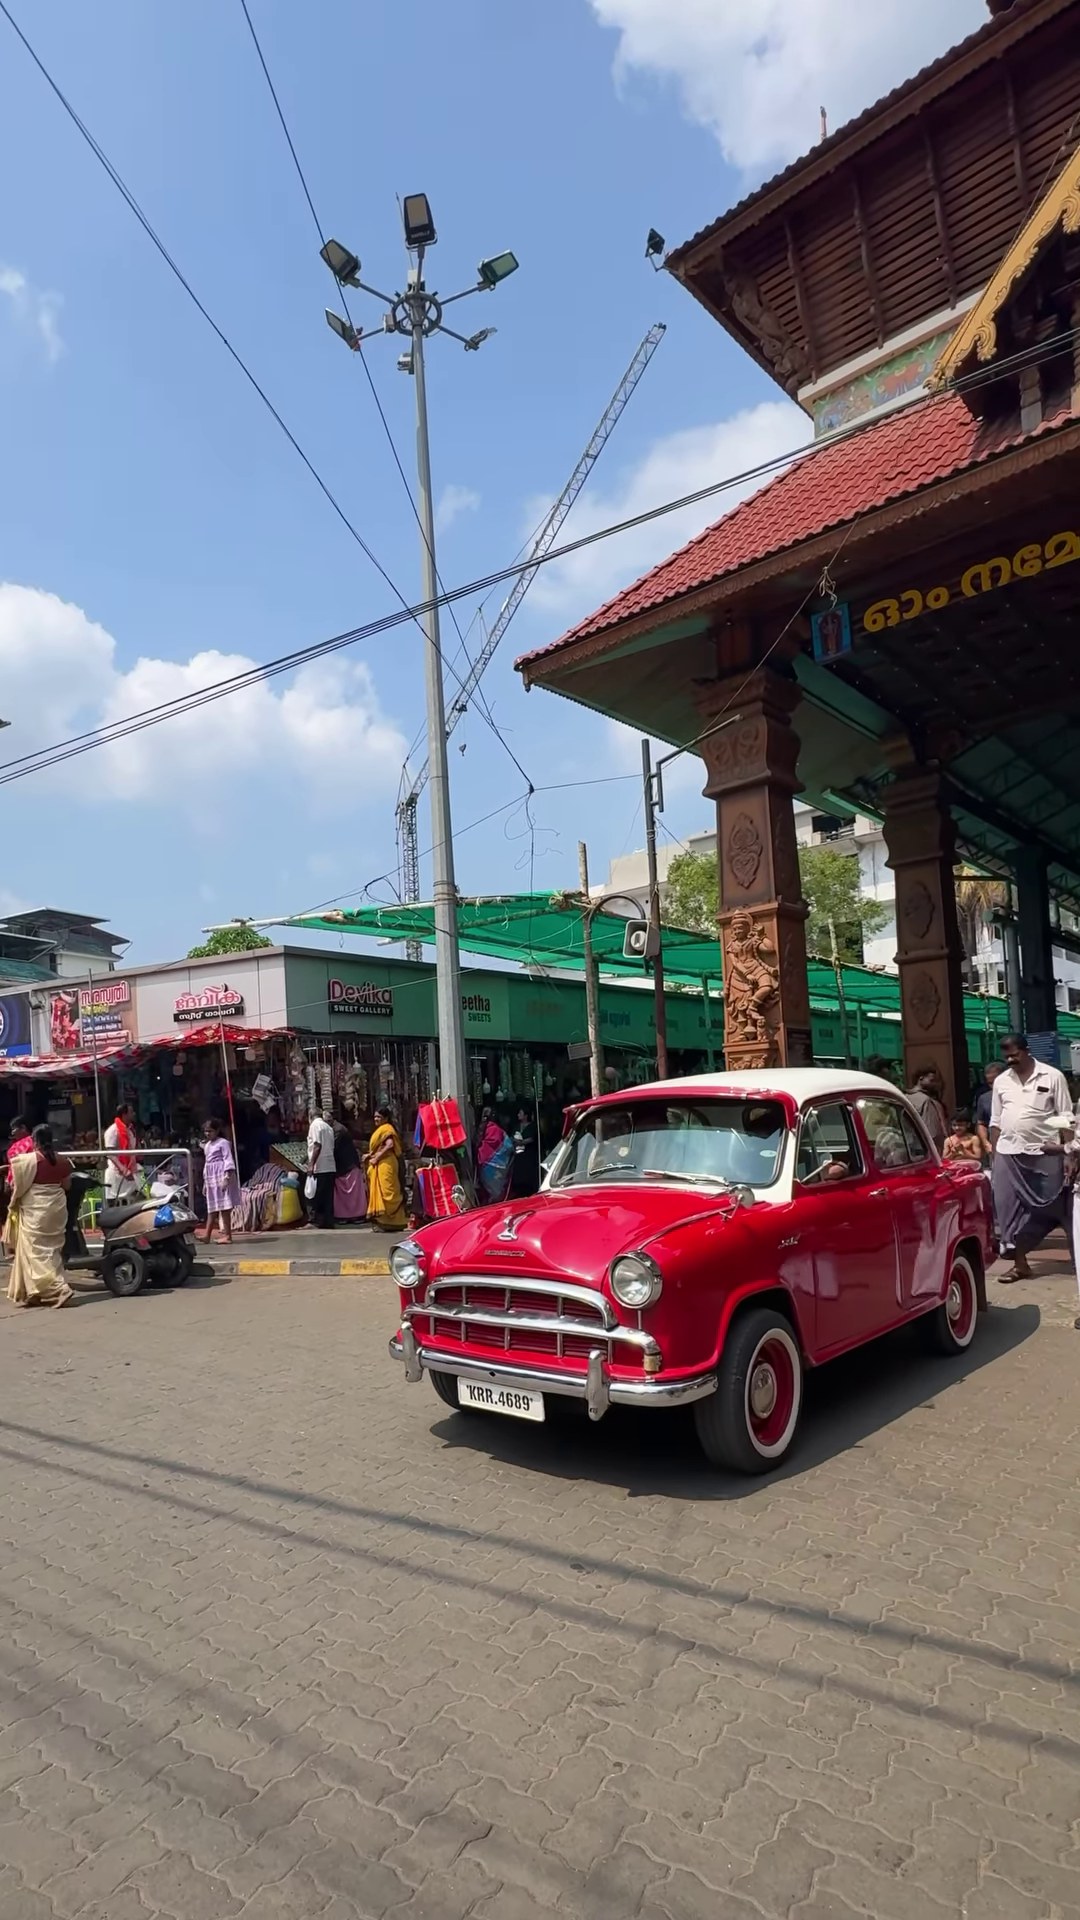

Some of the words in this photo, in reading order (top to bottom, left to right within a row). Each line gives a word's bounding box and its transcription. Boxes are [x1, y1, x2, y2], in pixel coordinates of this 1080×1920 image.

[864, 587, 950, 632] ഓം
[175, 984, 242, 1010] ദേവിക
[329, 979, 393, 1005] Devika
[334, 1004, 358, 1013] SWEET
[360, 1006, 390, 1015] GALLERY
[468, 1012, 491, 1023] SWEETS
